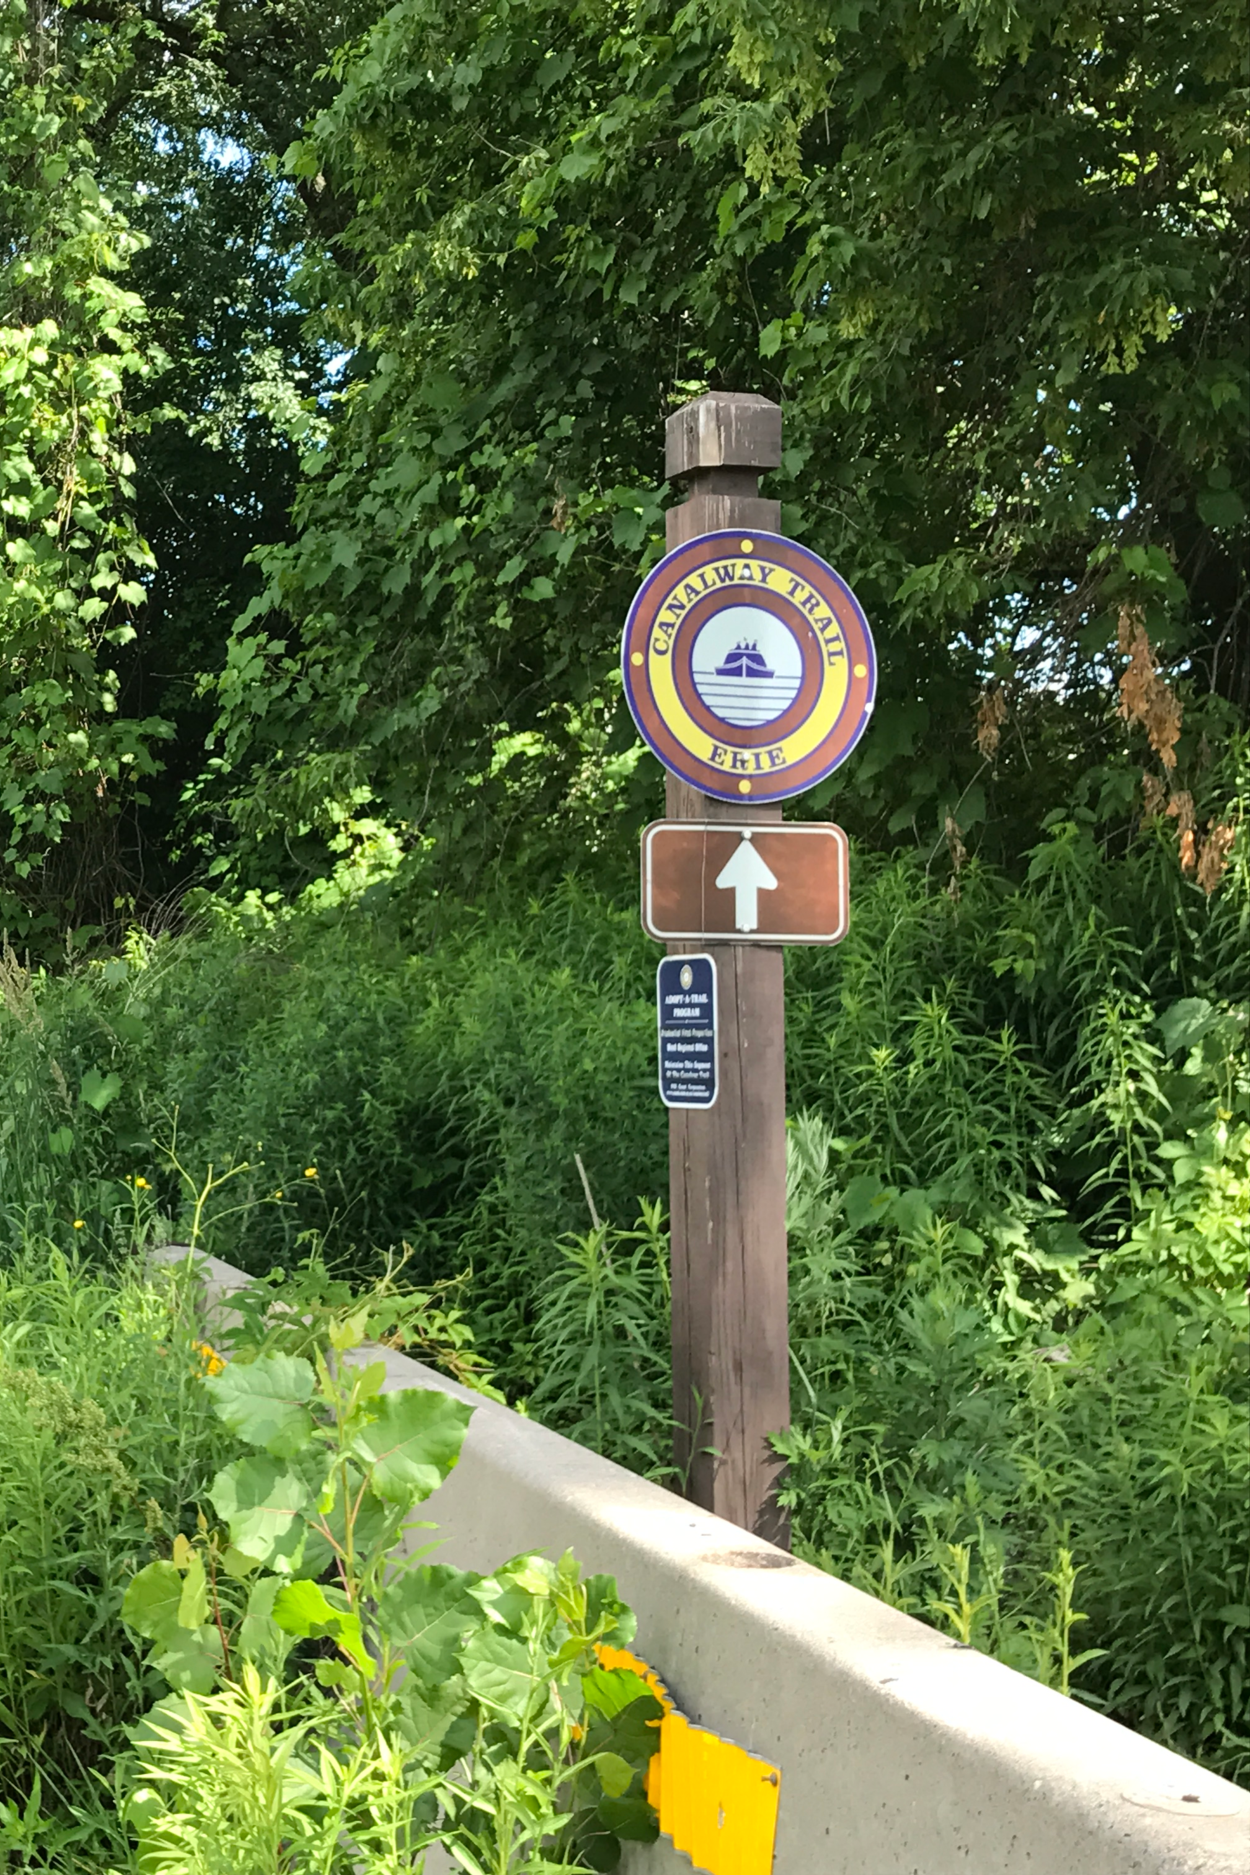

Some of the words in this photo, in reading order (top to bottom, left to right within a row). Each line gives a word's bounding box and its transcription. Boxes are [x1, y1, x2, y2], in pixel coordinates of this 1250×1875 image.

[652, 563, 776, 656] CANALWAY
[787, 577, 845, 667] TRAIL
[707, 743, 787, 771] ERIE
[673, 1007, 700, 1017] PROGRAM
